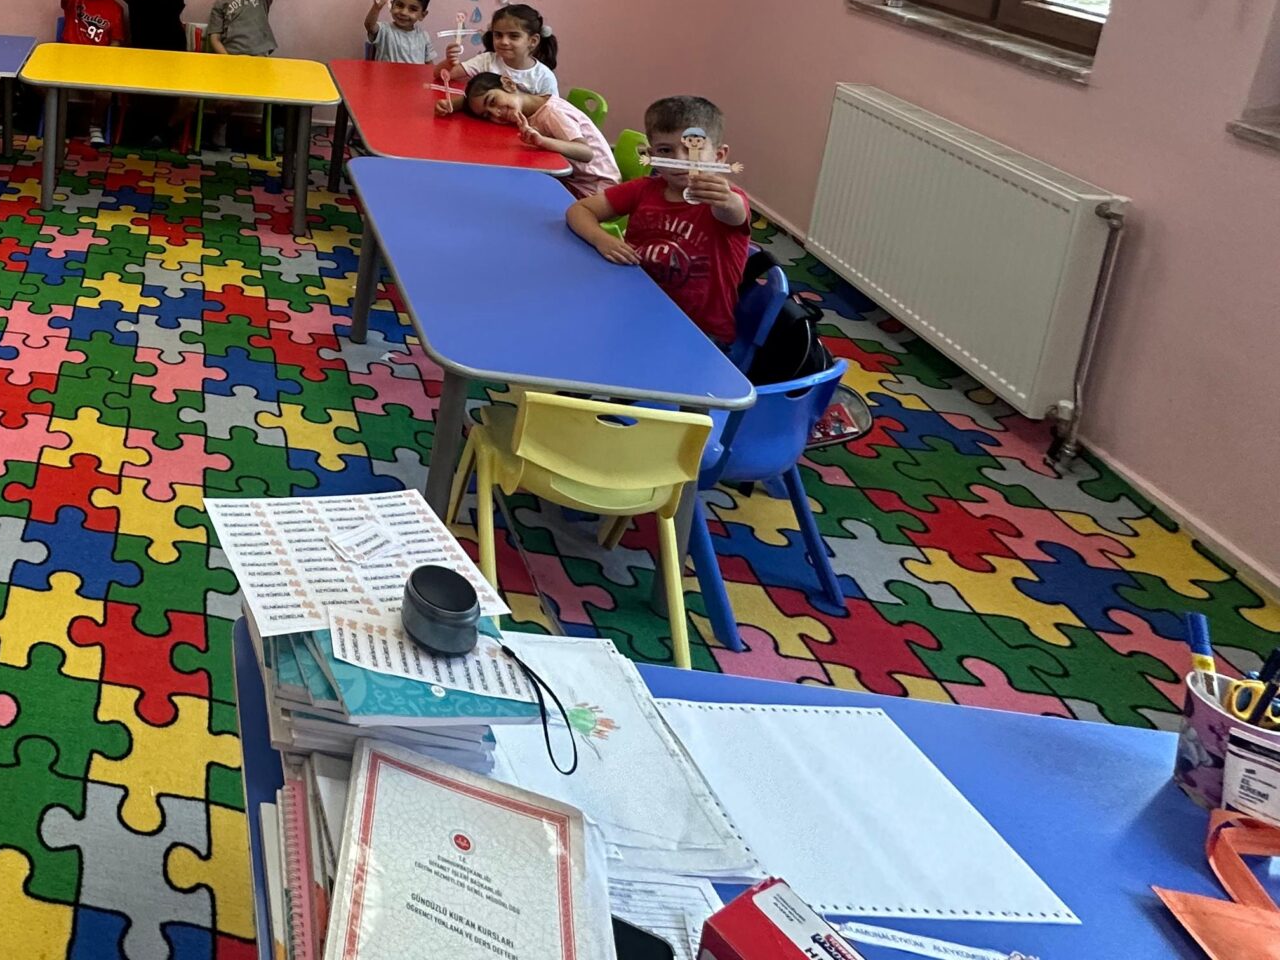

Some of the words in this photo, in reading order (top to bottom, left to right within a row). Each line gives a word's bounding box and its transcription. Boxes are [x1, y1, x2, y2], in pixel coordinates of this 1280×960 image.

[87, 25, 104, 42] 93
[410, 892, 448, 916] GÜNDÜZLÜ
[477, 924, 515, 948] KURSLARI
